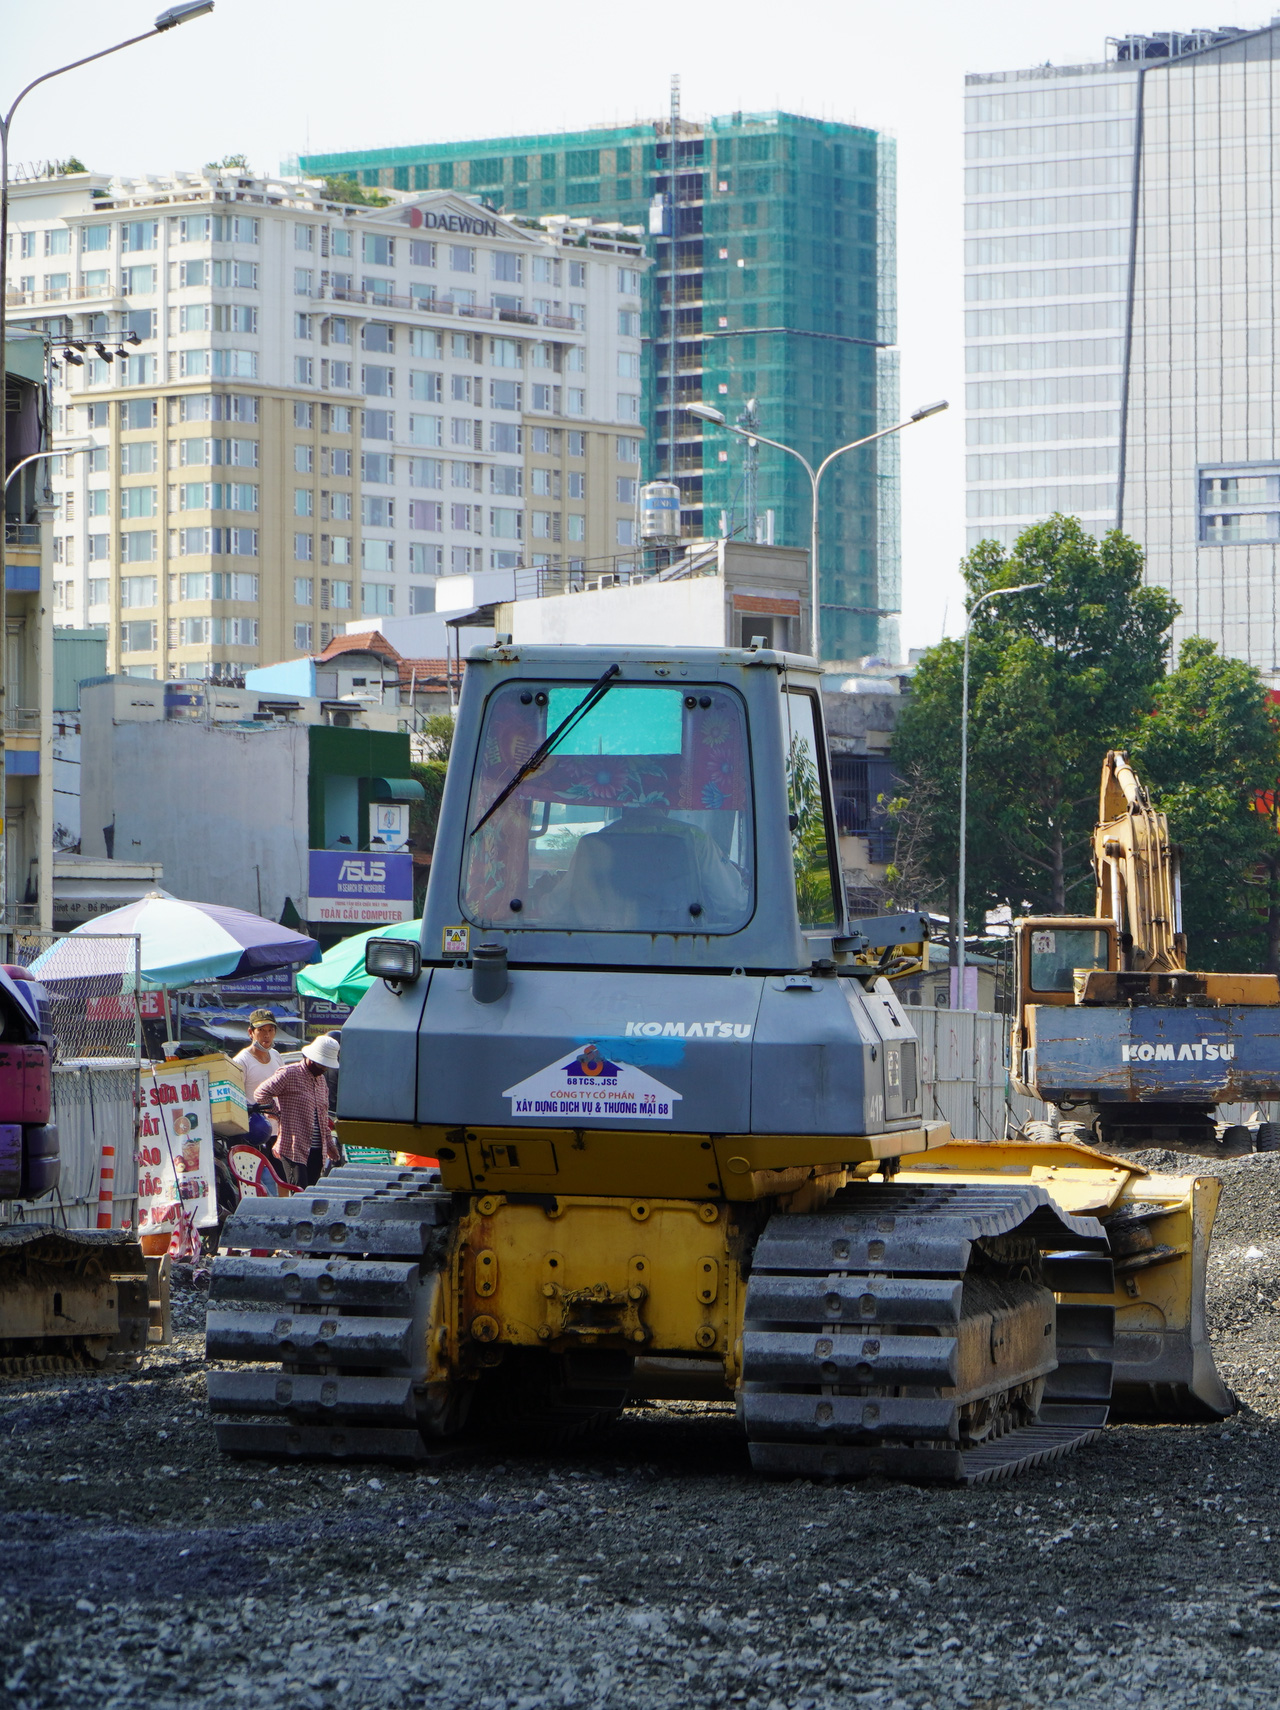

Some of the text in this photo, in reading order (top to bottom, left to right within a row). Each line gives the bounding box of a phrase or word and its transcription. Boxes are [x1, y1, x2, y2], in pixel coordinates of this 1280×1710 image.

[424, 212, 497, 237] DAEWON
[338, 860, 387, 882] ASUS
[342, 884, 357, 893] SEARCH
[364, 885, 386, 894] INCREDIBLE
[70, 903, 81, 912] 4P
[320, 907, 341, 919] TOÀN
[361, 909, 403, 920] COMPUTER
[309, 1002, 351, 1013] ASUS
[625, 1020, 752, 1039] KOMATSU
[1122, 1039, 1235, 1062] KOMATSU
[601, 1078, 618, 1086] JSC
[150, 1083, 178, 1106] SỮA
[181, 1080, 202, 1102] ĐÁ
[550, 1090, 578, 1099] CÔNG
[579, 1091, 593, 1099] TY
[516, 1098, 669, 1117] XÂY DỰNG DỊCH VỤ & THƯƠNG MẠI 68
